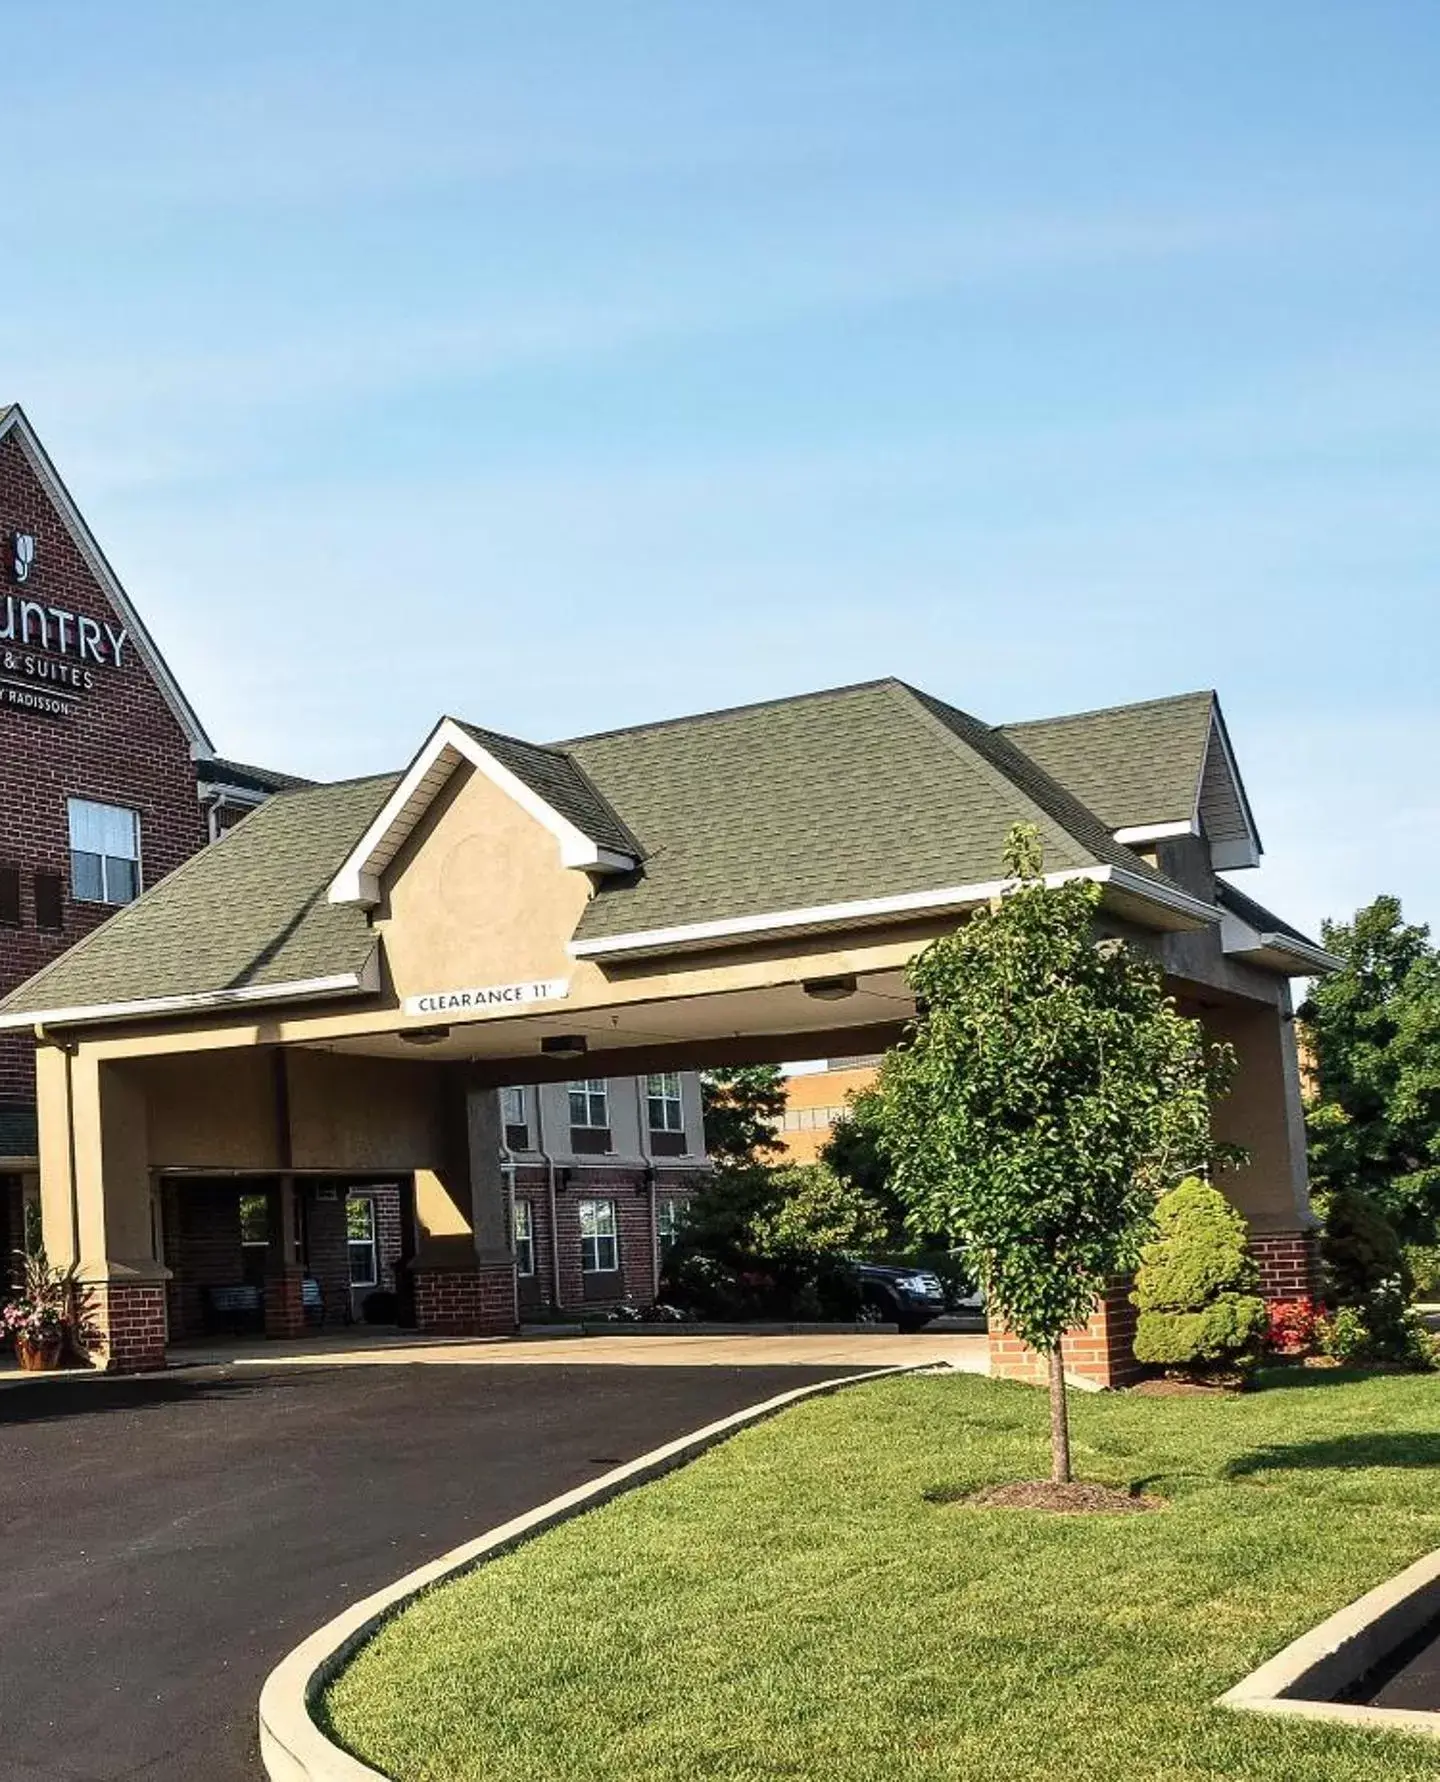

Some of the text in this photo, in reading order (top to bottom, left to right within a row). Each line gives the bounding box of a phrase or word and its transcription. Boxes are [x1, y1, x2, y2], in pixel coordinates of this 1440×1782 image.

[3, 651, 16, 670] &
[24, 656, 93, 689] SUITES
[9, 690, 68, 715] RADISSON
[418, 987, 523, 1012] CLEARANCE
